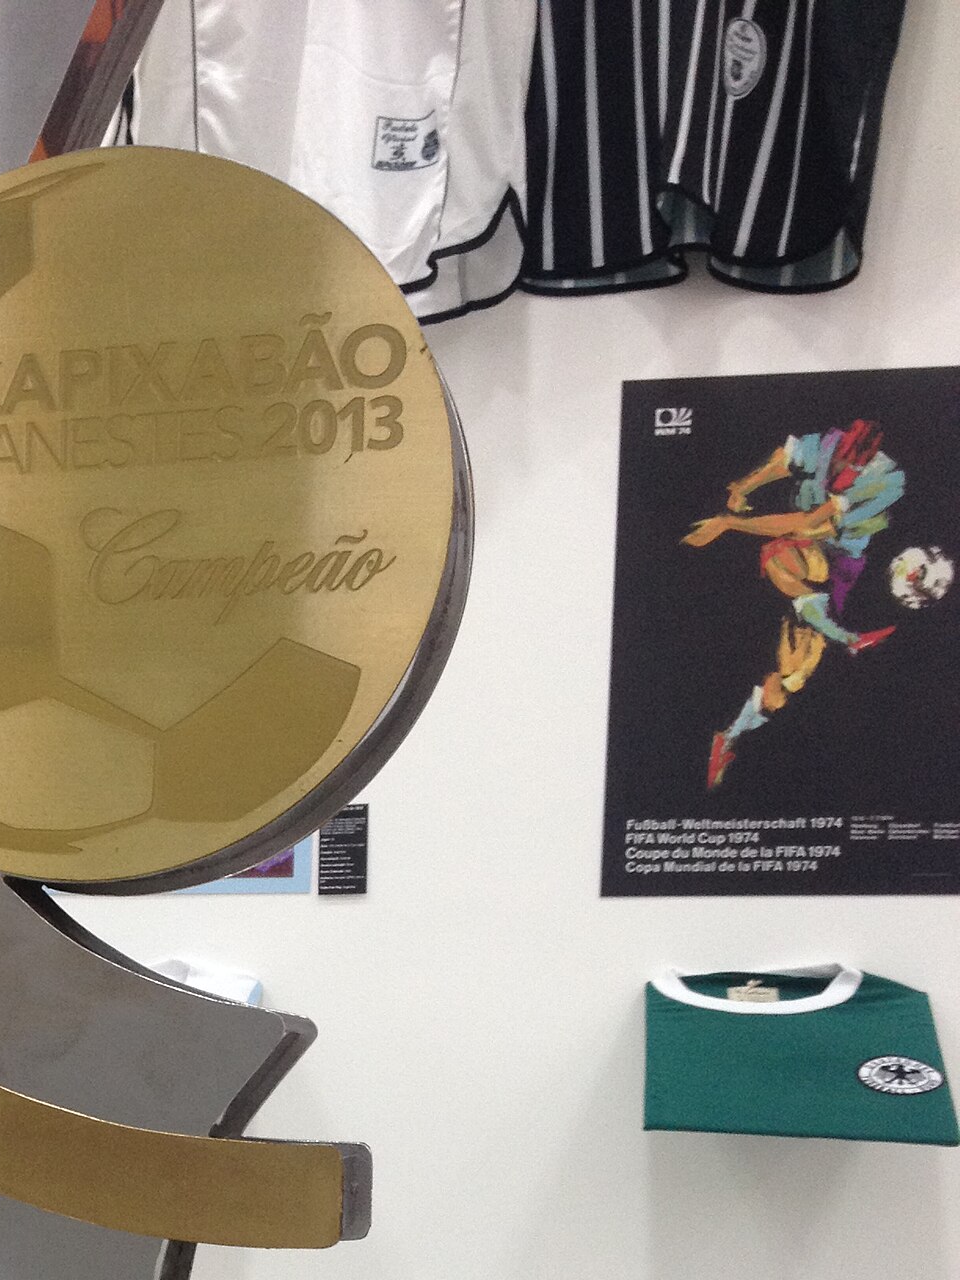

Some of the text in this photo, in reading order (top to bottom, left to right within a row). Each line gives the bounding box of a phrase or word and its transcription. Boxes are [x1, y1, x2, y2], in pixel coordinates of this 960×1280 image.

[261, 394, 405, 457] 2013
[79, 506, 397, 626] Campeão
[810, 817, 843, 828] 1974
[625, 832, 760, 846] FIFA World Cup 1974
[625, 846, 842, 861] Coupe du Monde de la FIFA 1974
[625, 861, 661, 875] Copa
[663, 861, 717, 873] Mundial
[718, 861, 736, 872] de
[753, 860, 784, 872] FIFA
[786, 860, 819, 871] 1974
